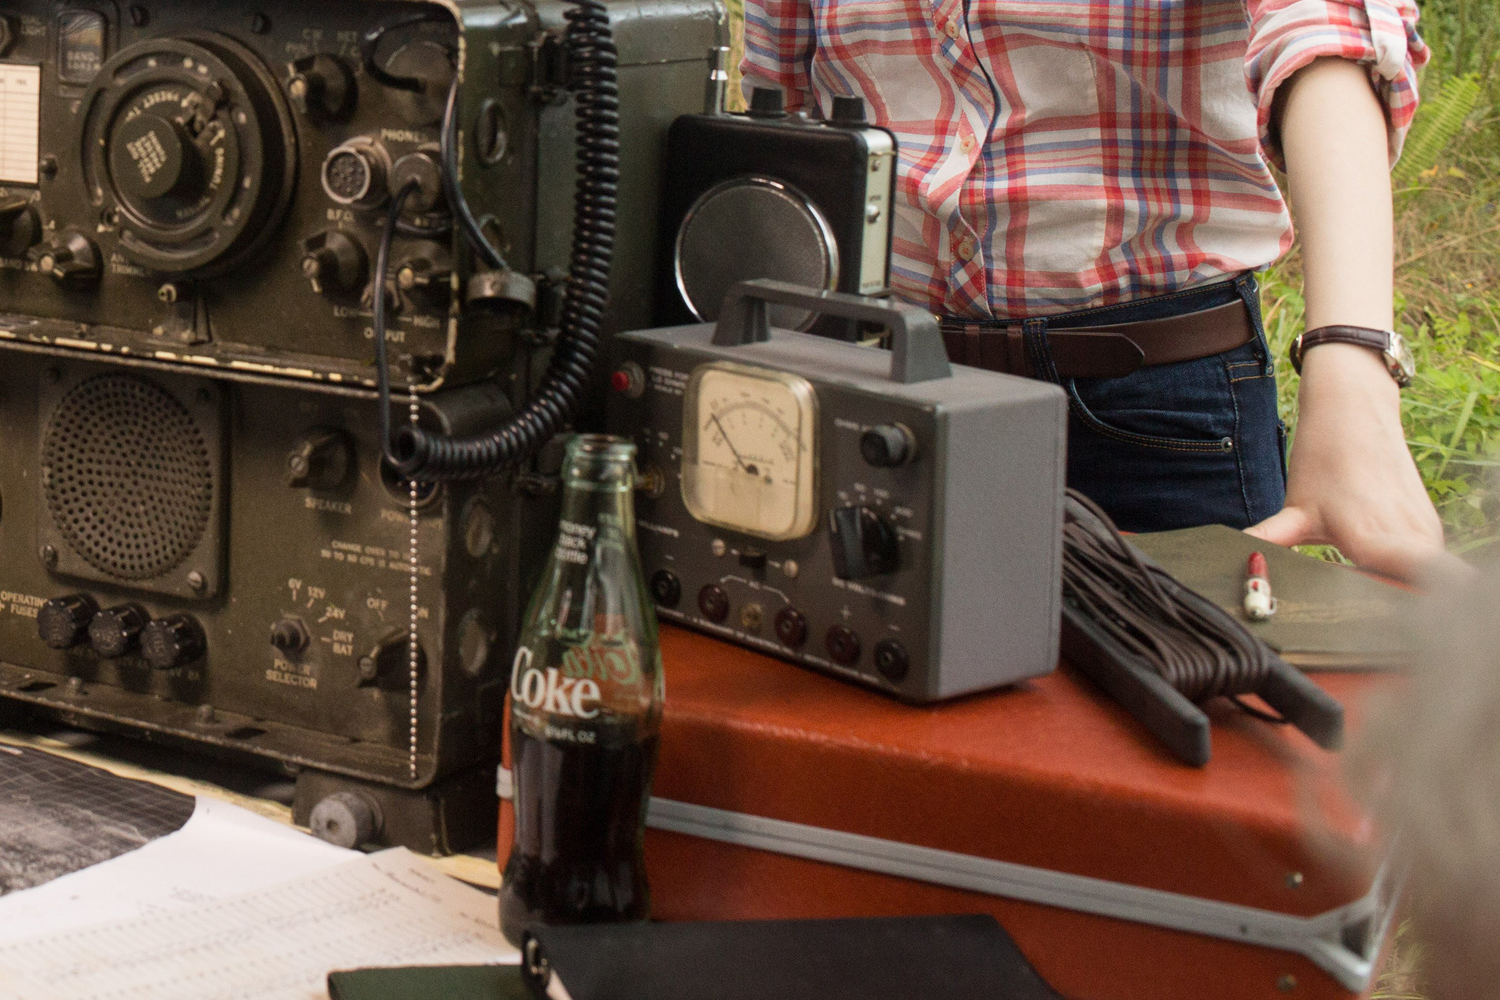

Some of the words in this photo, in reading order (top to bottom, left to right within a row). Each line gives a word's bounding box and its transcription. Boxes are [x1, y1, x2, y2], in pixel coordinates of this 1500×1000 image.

[363, 325, 406, 343] OPUT
[304, 495, 352, 515] SPEAKER
[331, 540, 362, 553] CHANGE
[287, 577, 302, 590] 6V
[0, 590, 49, 608] OPERATIN
[307, 586, 326, 600] 12V
[10, 603, 40, 619] FUSES
[366, 597, 388, 611] OFF
[325, 606, 346, 620] 24V
[332, 629, 354, 644] DRY
[332, 642, 354, 657] BAT
[274, 658, 311, 676] POWER
[265, 669, 318, 690] SELECTOR
[511, 645, 601, 719] Coke
